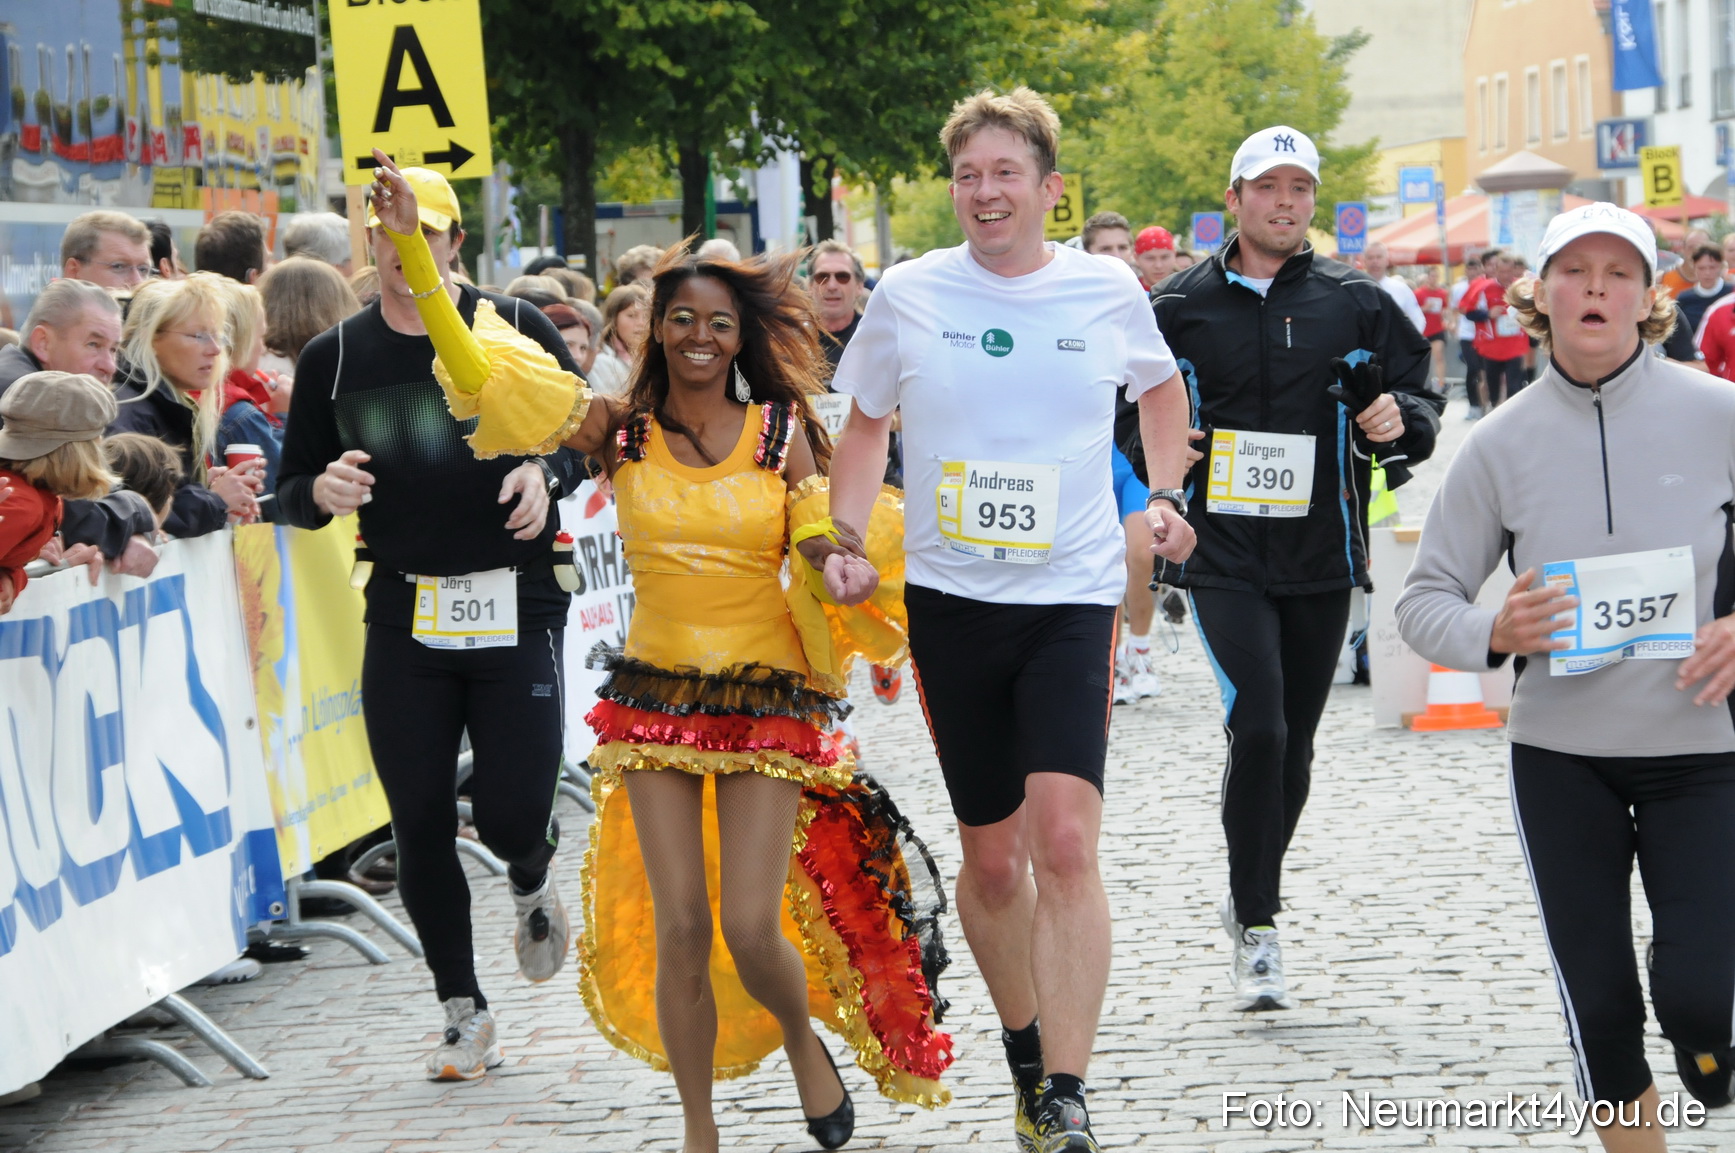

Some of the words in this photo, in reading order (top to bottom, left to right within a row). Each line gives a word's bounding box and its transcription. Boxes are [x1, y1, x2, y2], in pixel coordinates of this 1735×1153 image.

[372, 24, 456, 133] A
[1273, 133, 1296, 152] NY
[1646, 148, 1679, 160] Block
[1653, 164, 1674, 193] B
[1054, 193, 1073, 223] B
[942, 331, 976, 342] Bühler
[950, 340, 976, 349] Motor
[985, 344, 1010, 353] Bühler
[1238, 440, 1285, 460] Jürgen
[1214, 462, 1221, 474] C
[969, 469, 1034, 492] Andreas
[1246, 466, 1295, 491] 390
[940, 495, 948, 508] C
[978, 501, 1036, 532] 953
[441, 576, 472, 593] Jörg
[420, 596, 426, 608] C
[450, 598, 495, 622] 501
[1594, 592, 1679, 631] 3557
[1637, 641, 1692, 651] PFLEIDERER
[0, 573, 232, 935] OCK
